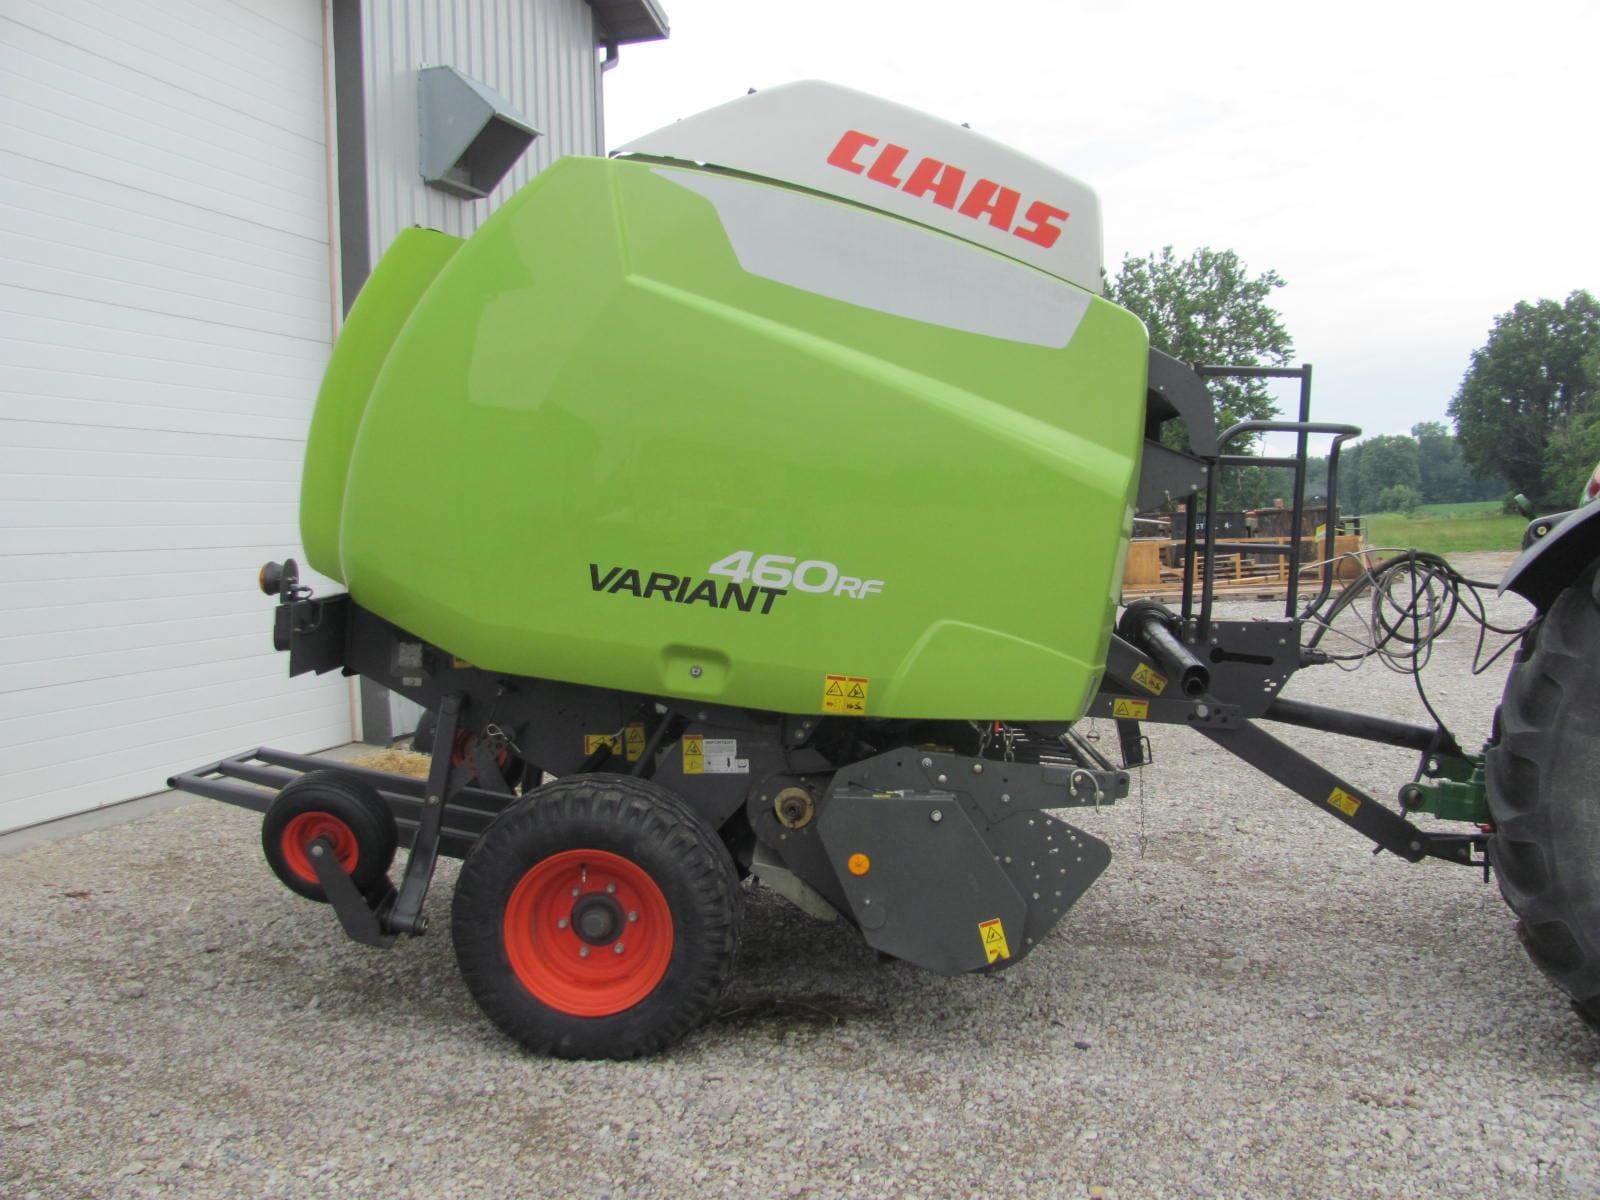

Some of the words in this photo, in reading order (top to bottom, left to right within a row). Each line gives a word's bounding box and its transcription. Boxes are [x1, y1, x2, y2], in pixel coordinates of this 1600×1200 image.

[826, 130, 1071, 249] CLAAS
[589, 563, 788, 615] VARIANT
[709, 551, 885, 599] 460RF
